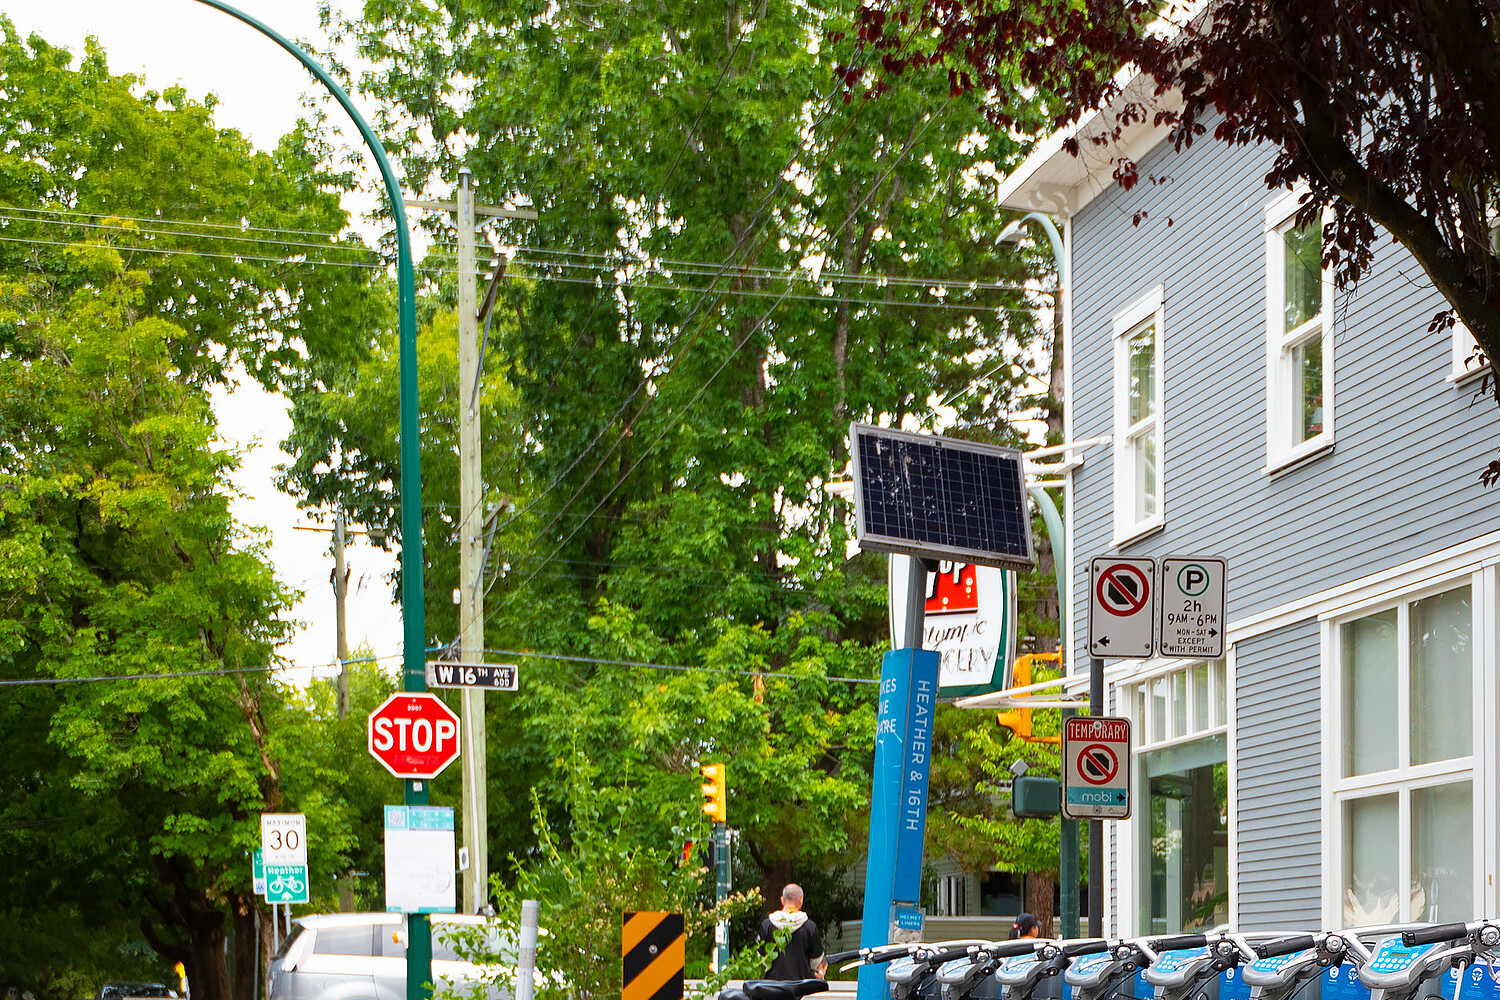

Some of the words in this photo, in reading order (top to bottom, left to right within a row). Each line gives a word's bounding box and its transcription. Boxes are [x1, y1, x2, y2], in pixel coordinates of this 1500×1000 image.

[1186, 570, 1204, 590] P
[1183, 600, 1202, 612] 2h
[923, 617, 988, 650] lympic
[438, 666, 454, 684] W
[459, 667, 489, 685] 16TH
[493, 669, 510, 677] AVE
[493, 678, 510, 687] 600
[911, 680, 930, 764] HEATHER
[1069, 723, 1127, 739] TEMPORARY
[374, 717, 456, 752] STOP
[910, 770, 923, 782] &
[1081, 791, 1112, 802] mobi
[906, 789, 921, 830] 16TH
[270, 829, 299, 850] 30
[267, 867, 304, 875] Heather
